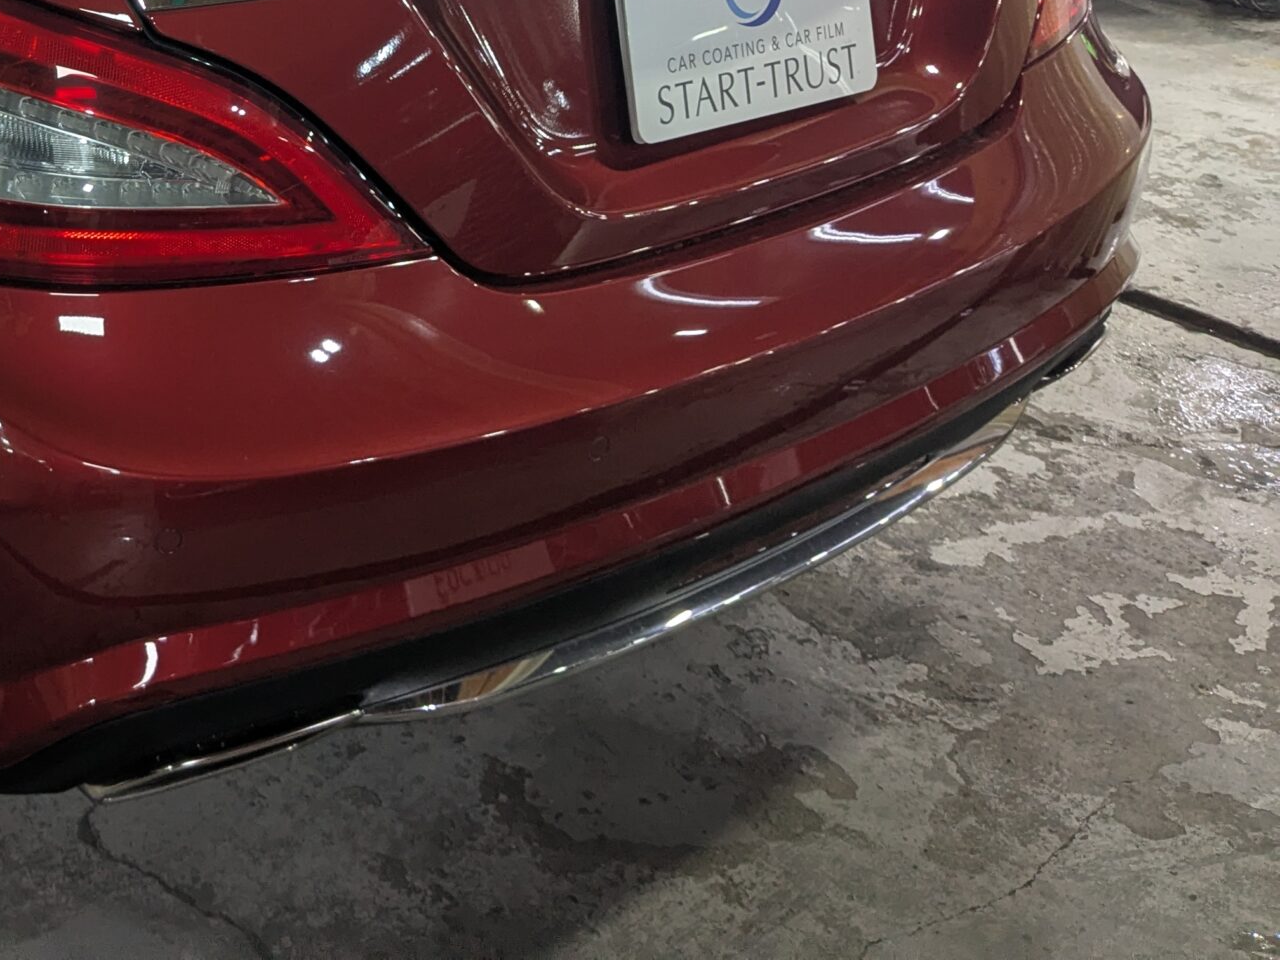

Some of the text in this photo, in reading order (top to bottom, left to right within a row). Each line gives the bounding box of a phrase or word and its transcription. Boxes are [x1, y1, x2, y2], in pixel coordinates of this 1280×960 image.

[667, 22, 844, 73] CAR COATING & CAR FILM
[657, 43, 856, 125] START-TRUST
